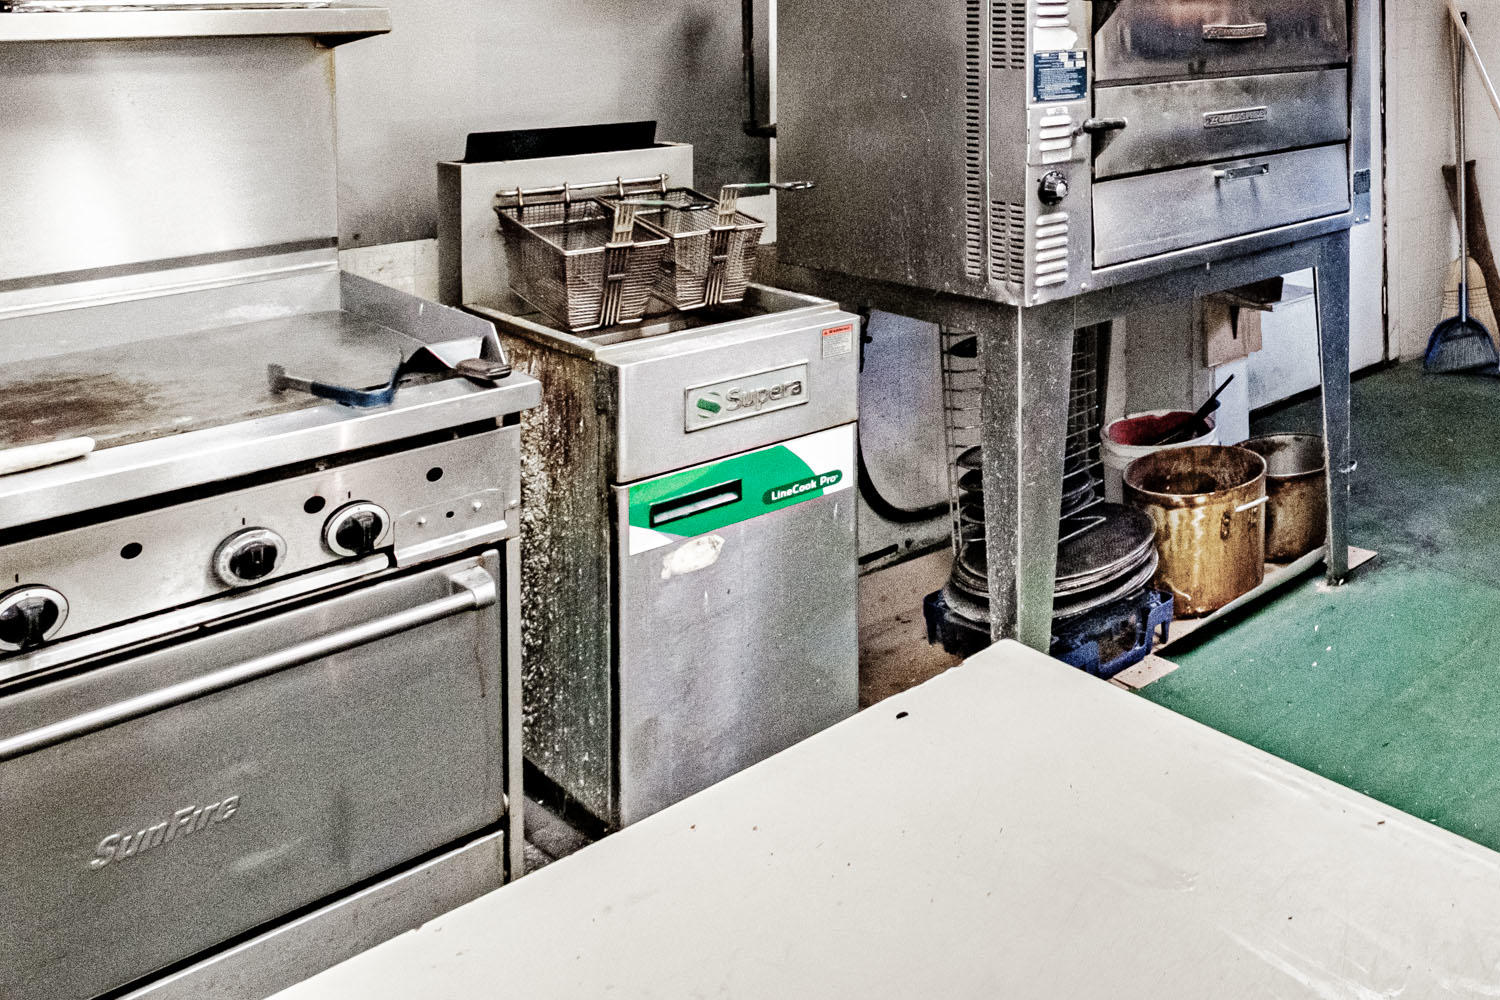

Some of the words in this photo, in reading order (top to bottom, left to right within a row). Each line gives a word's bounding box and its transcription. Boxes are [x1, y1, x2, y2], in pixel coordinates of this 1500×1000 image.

[726, 380, 802, 411] Supera
[771, 479, 817, 501] LineCook
[820, 474, 838, 486] Pro
[88, 796, 240, 871] SunFire
